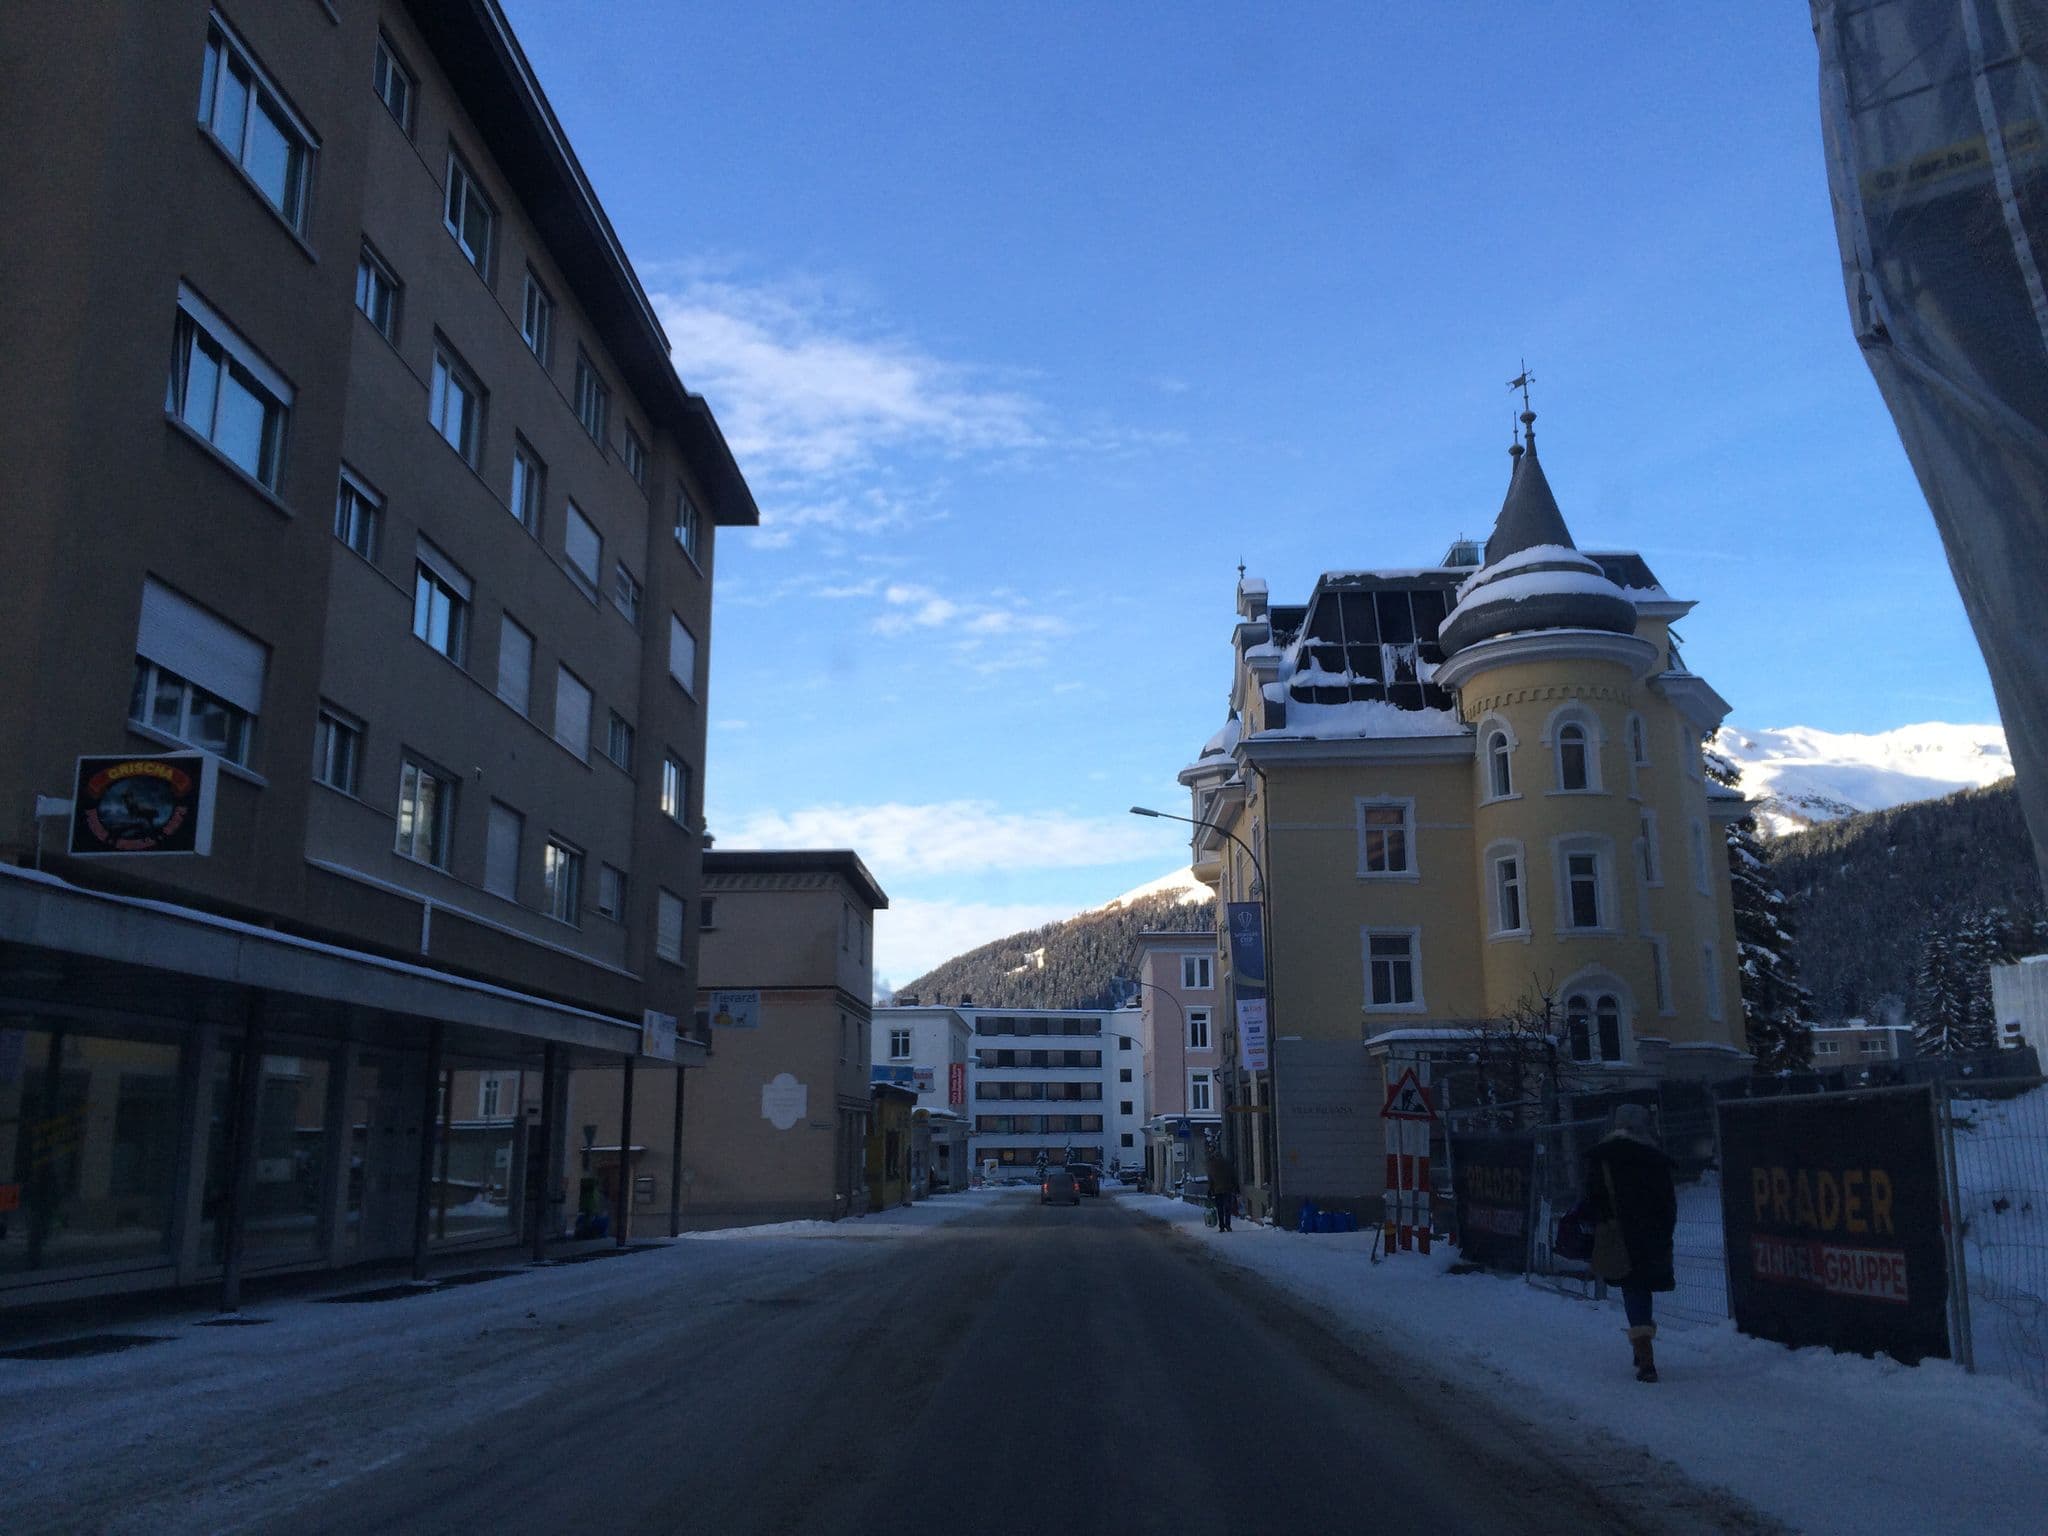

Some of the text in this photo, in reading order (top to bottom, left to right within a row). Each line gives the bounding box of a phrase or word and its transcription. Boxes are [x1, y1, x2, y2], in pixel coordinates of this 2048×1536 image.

[107, 761, 174, 780] GRISCHA
[1751, 1167, 1895, 1236] PRADER
[1823, 1251, 1906, 1296] GRUPPE
